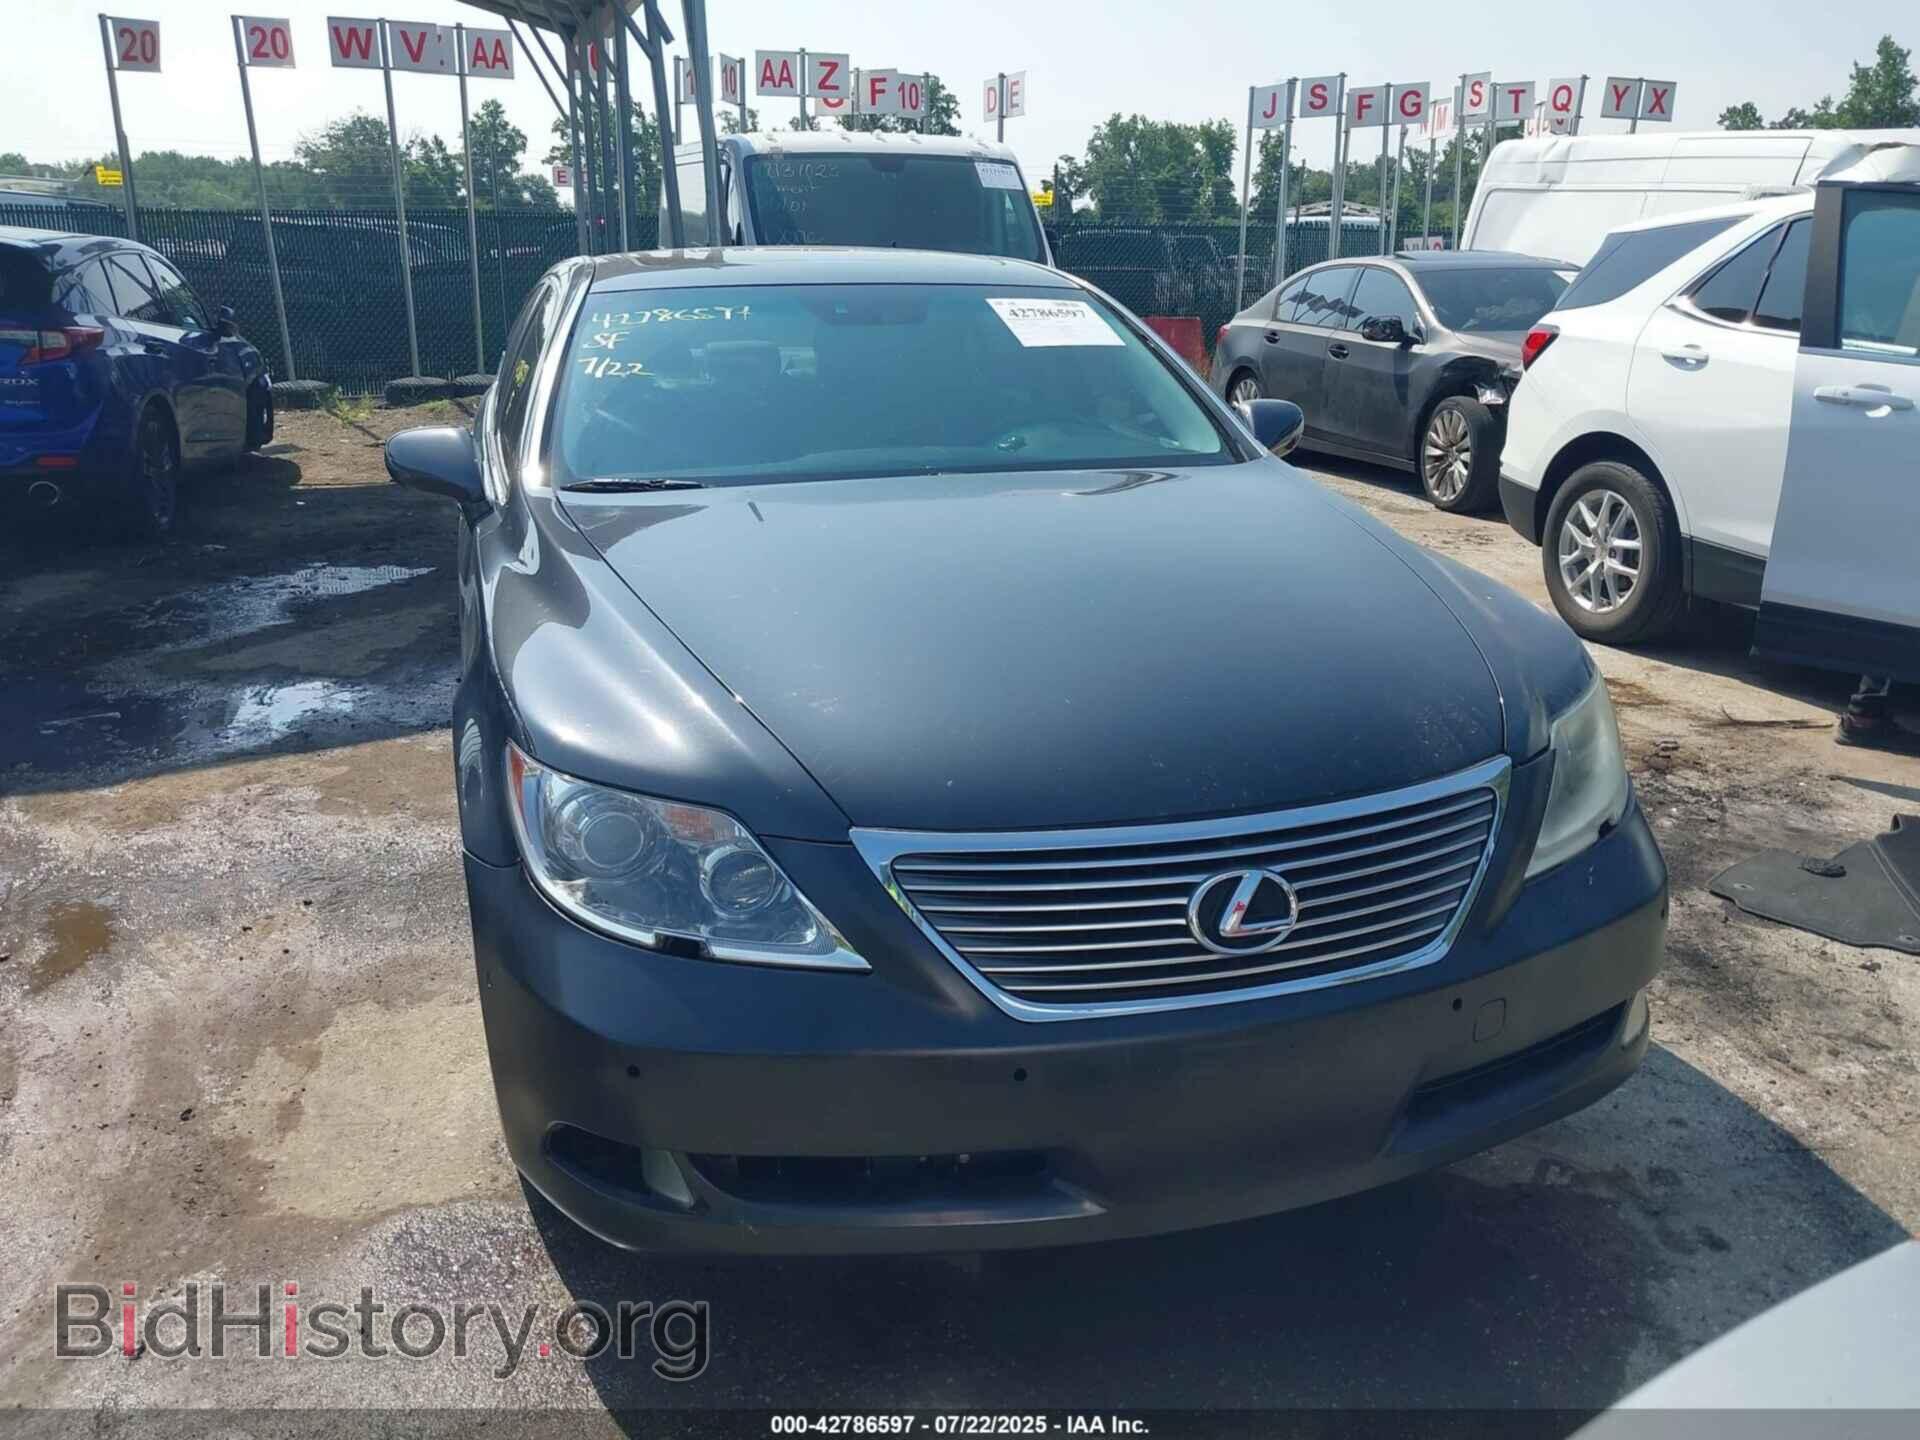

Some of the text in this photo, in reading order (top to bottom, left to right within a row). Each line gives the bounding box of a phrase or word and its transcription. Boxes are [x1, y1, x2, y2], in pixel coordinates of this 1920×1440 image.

[119, 28, 157, 63] 20
[250, 26, 289, 59] 20
[333, 26, 373, 60] W
[400, 30, 427, 63] V
[472, 37, 509, 70] AA
[722, 64, 737, 95] 10
[760, 58, 794, 88] AA
[818, 61, 840, 91] Z
[870, 77, 887, 106] F
[898, 81, 919, 110] 10
[987, 86, 997, 113] D
[1010, 79, 1020, 109] E
[1263, 92, 1277, 119] J
[1309, 83, 1328, 110] S
[1400, 89, 1422, 117] G
[1469, 80, 1483, 107] S
[1508, 89, 1526, 113] T
[1552, 84, 1573, 113] Q
[1612, 84, 1631, 112] Y
[1648, 87, 1668, 114] X
[1357, 94, 1375, 120] F
[557, 170, 568, 184] E
